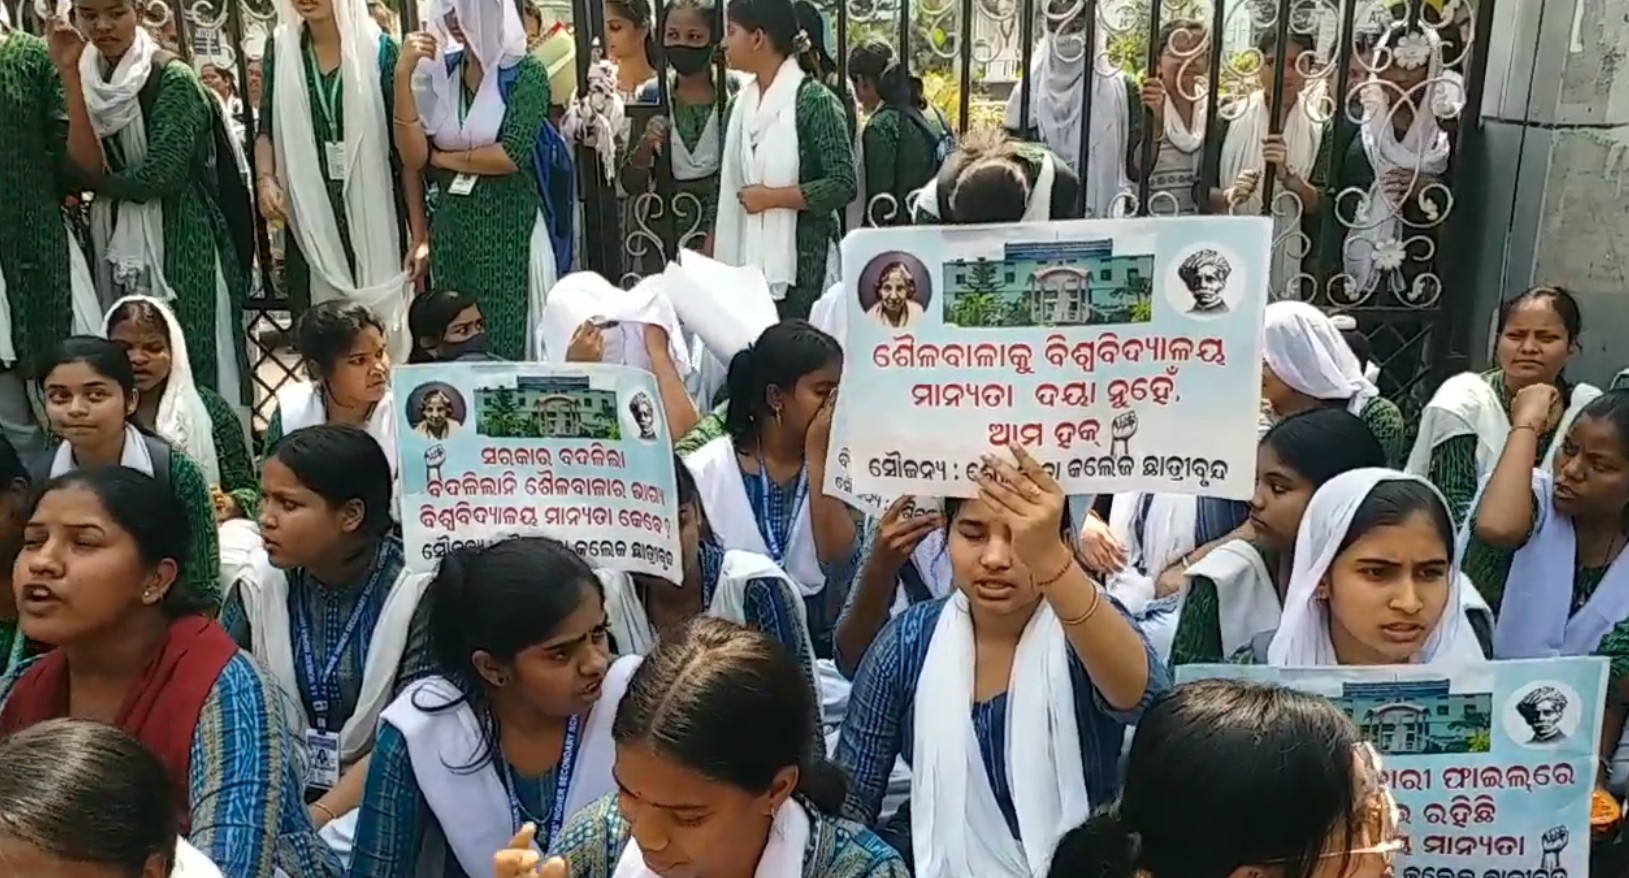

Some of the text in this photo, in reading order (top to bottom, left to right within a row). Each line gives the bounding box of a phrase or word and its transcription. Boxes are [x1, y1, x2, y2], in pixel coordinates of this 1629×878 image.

[911, 383, 1013, 407] ମାନ୍ୟତା
[1035, 382, 1096, 407] ଦୟା
[988, 423, 1043, 447] ଆମ
[481, 442, 626, 468] ସରକାର ବଦଳିଲା
[1067, 456, 1134, 478] କଲେଜ
[427, 470, 517, 497] ବଦଳିଲାନି
[525, 470, 626, 498] ଶୈଳବାଳାର
[545, 507, 613, 525] ମାନ୍ୟତା
[574, 540, 627, 558] କଲେଜ
[1423, 794, 1496, 828] ରହିଛି
[1422, 834, 1525, 856] ମାନ୍ୟତା
